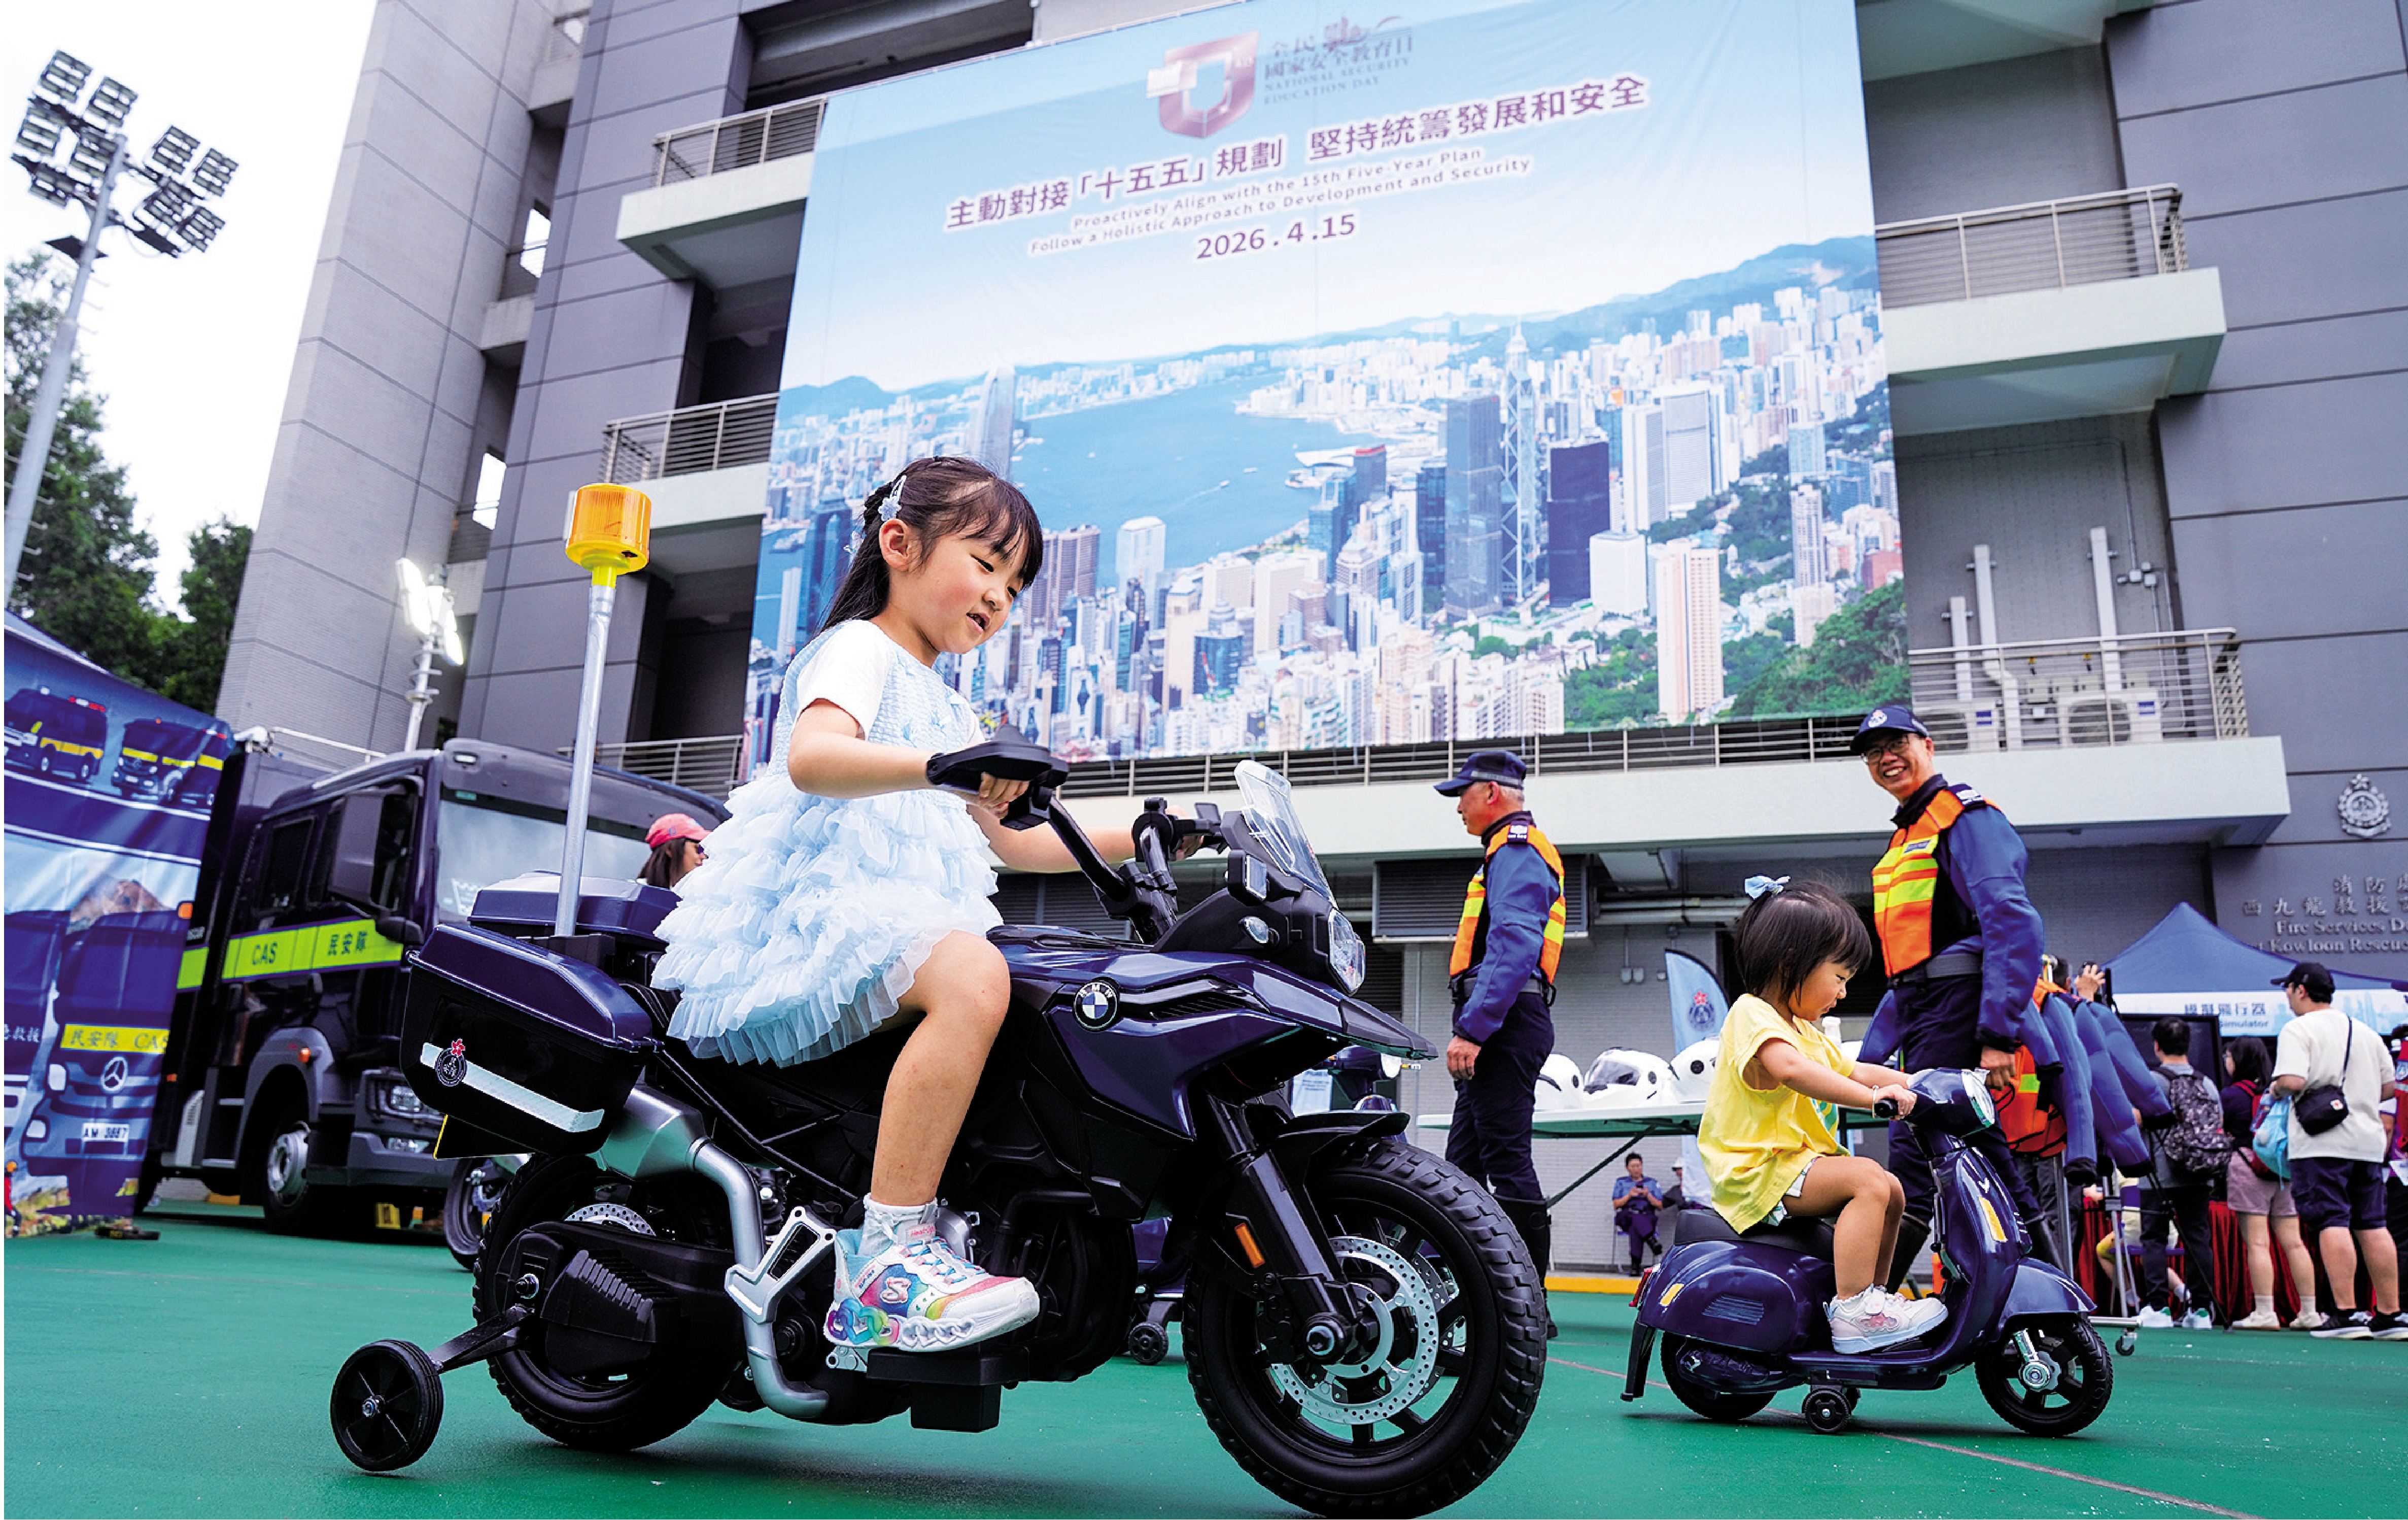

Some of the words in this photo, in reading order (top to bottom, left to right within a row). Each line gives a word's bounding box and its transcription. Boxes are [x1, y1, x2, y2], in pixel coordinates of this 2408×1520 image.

[1264, 71, 1333, 91] NATIONAL
[1264, 82, 1347, 105] EDUCATION
[1352, 76, 1379, 89] DAY
[1310, 77, 1645, 161] 堅持統籌發展和安全
[1074, 202, 1167, 229] Proactively
[1174, 194, 1217, 209] Align
[1223, 185, 1261, 200] with
[1267, 181, 1295, 193] the
[1303, 171, 1341, 187] 15th
[1347, 158, 1432, 180] Five-Year
[1440, 151, 1480, 164] Plan
[1031, 237, 1084, 253] Follow
[1089, 234, 1096, 242] a
[1103, 220, 1164, 240] Holistic
[1172, 205, 1252, 227] Approach
[1259, 201, 1276, 212] to
[1283, 179, 1402, 208] Development
[1410, 171, 1443, 187] and
[1451, 158, 1531, 181] Security
[2275, 920, 2309, 936] Fire
[2313, 919, 2386, 935] Services
[252, 942, 278, 965] CAS
[327, 930, 368, 956] 民安隊
[2268, 938, 2345, 954] Kowloon
[1079, 983, 1114, 999] BMW
